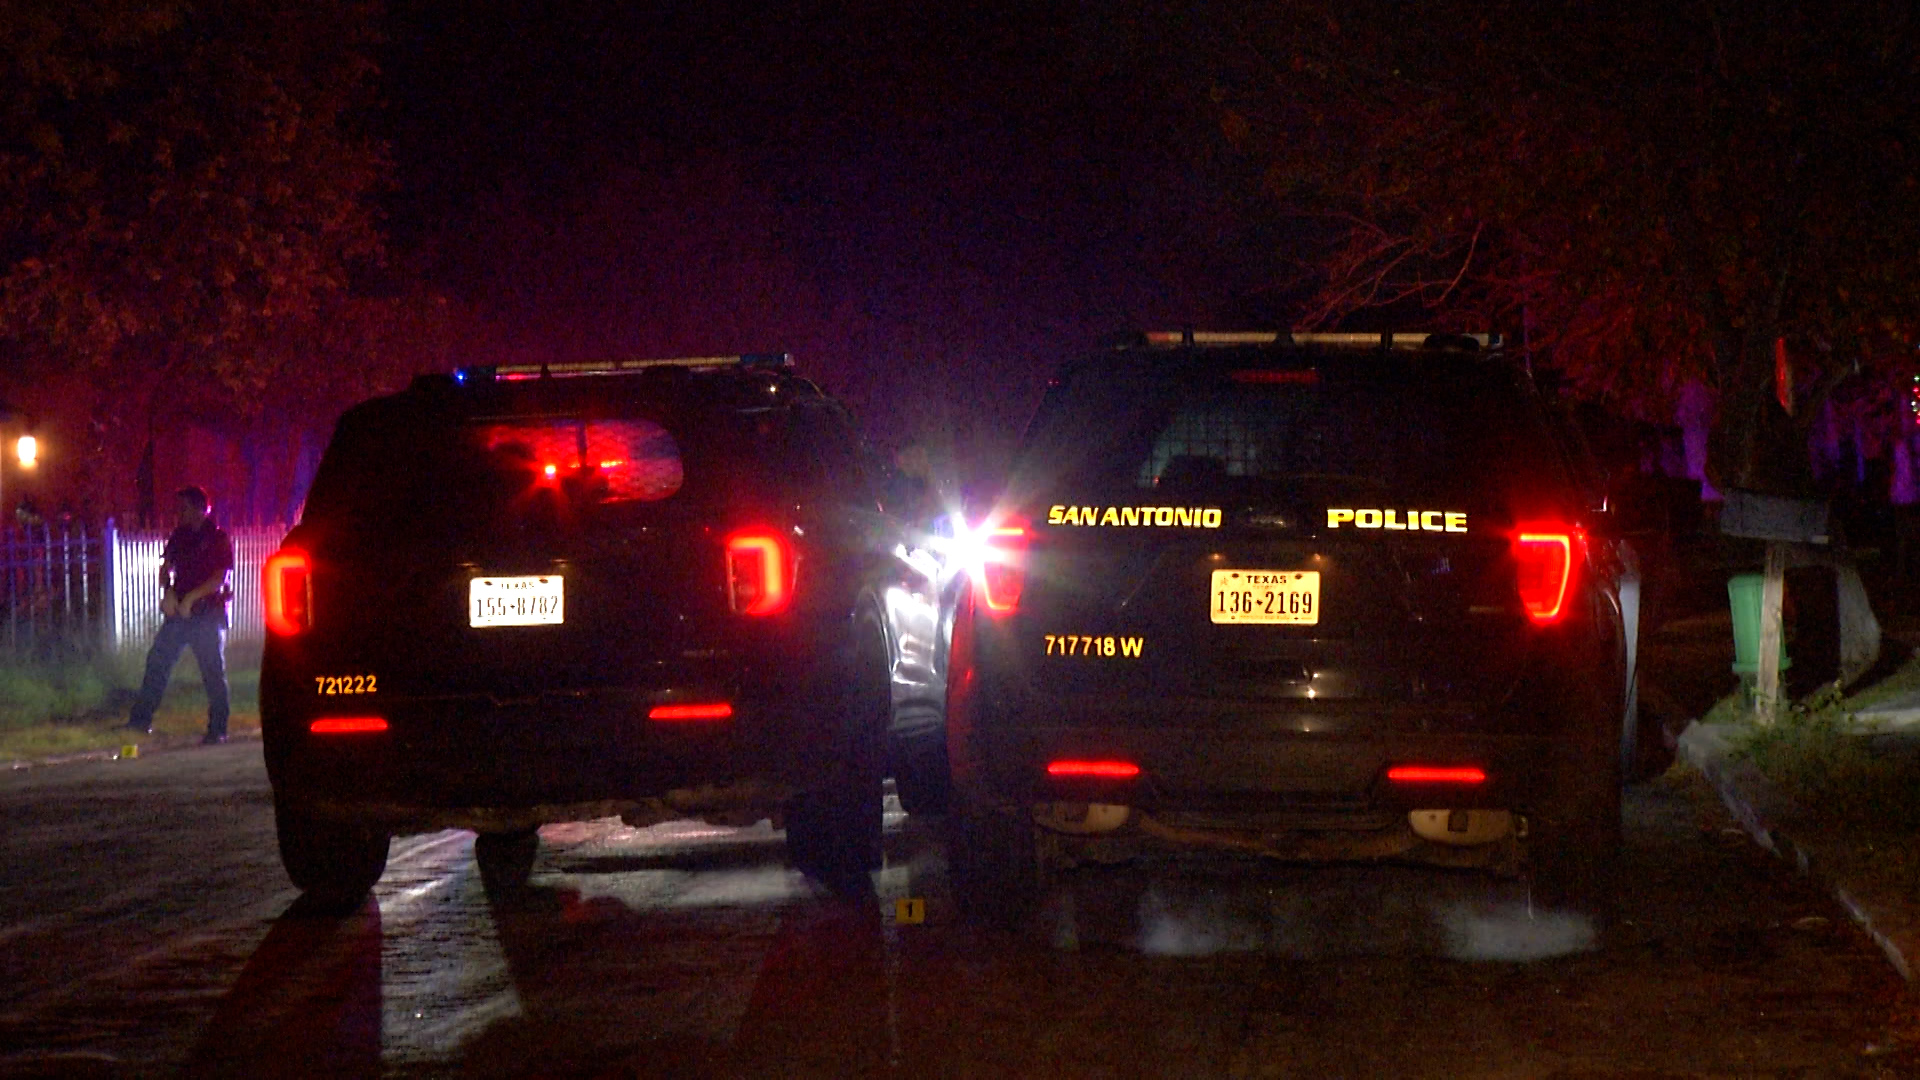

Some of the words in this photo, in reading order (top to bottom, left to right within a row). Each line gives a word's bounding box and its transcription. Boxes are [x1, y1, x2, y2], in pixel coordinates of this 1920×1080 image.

[1048, 504, 1099, 526] SAN
[1099, 506, 1222, 528] ANTONIO
[1327, 508, 1468, 533] POLICE
[1246, 575, 1287, 584] TEXAS
[1044, 635, 1116, 657] 717718
[1120, 637, 1144, 658] W
[315, 674, 378, 695] 721222
